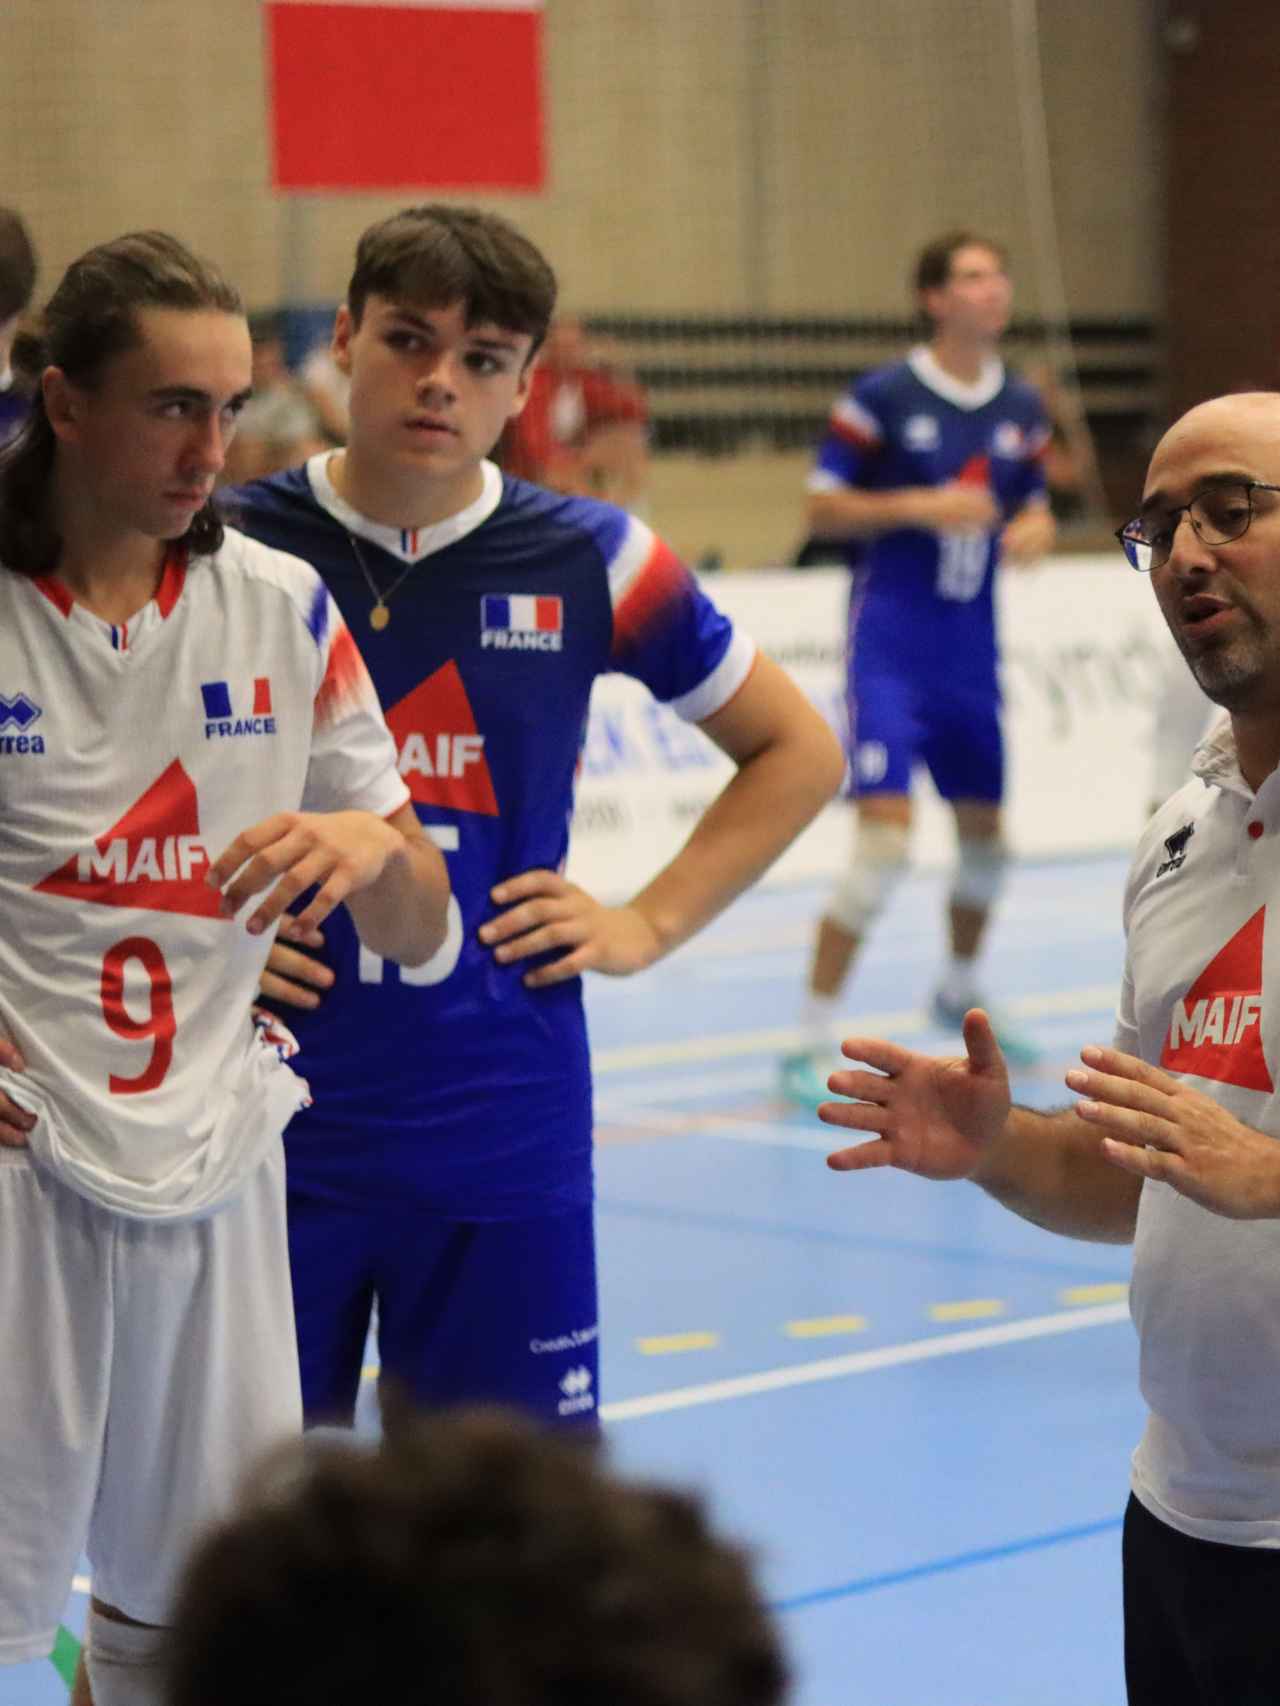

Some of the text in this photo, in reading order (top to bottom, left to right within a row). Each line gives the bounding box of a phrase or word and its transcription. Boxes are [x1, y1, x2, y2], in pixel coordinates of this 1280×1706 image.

[481, 631, 562, 652] FRANCE
[205, 717, 276, 740] FRANCE
[397, 732, 485, 778] AIF
[78, 834, 206, 884] MAIF
[100, 936, 176, 1095] 9
[1169, 995, 1265, 1050] MAIF
